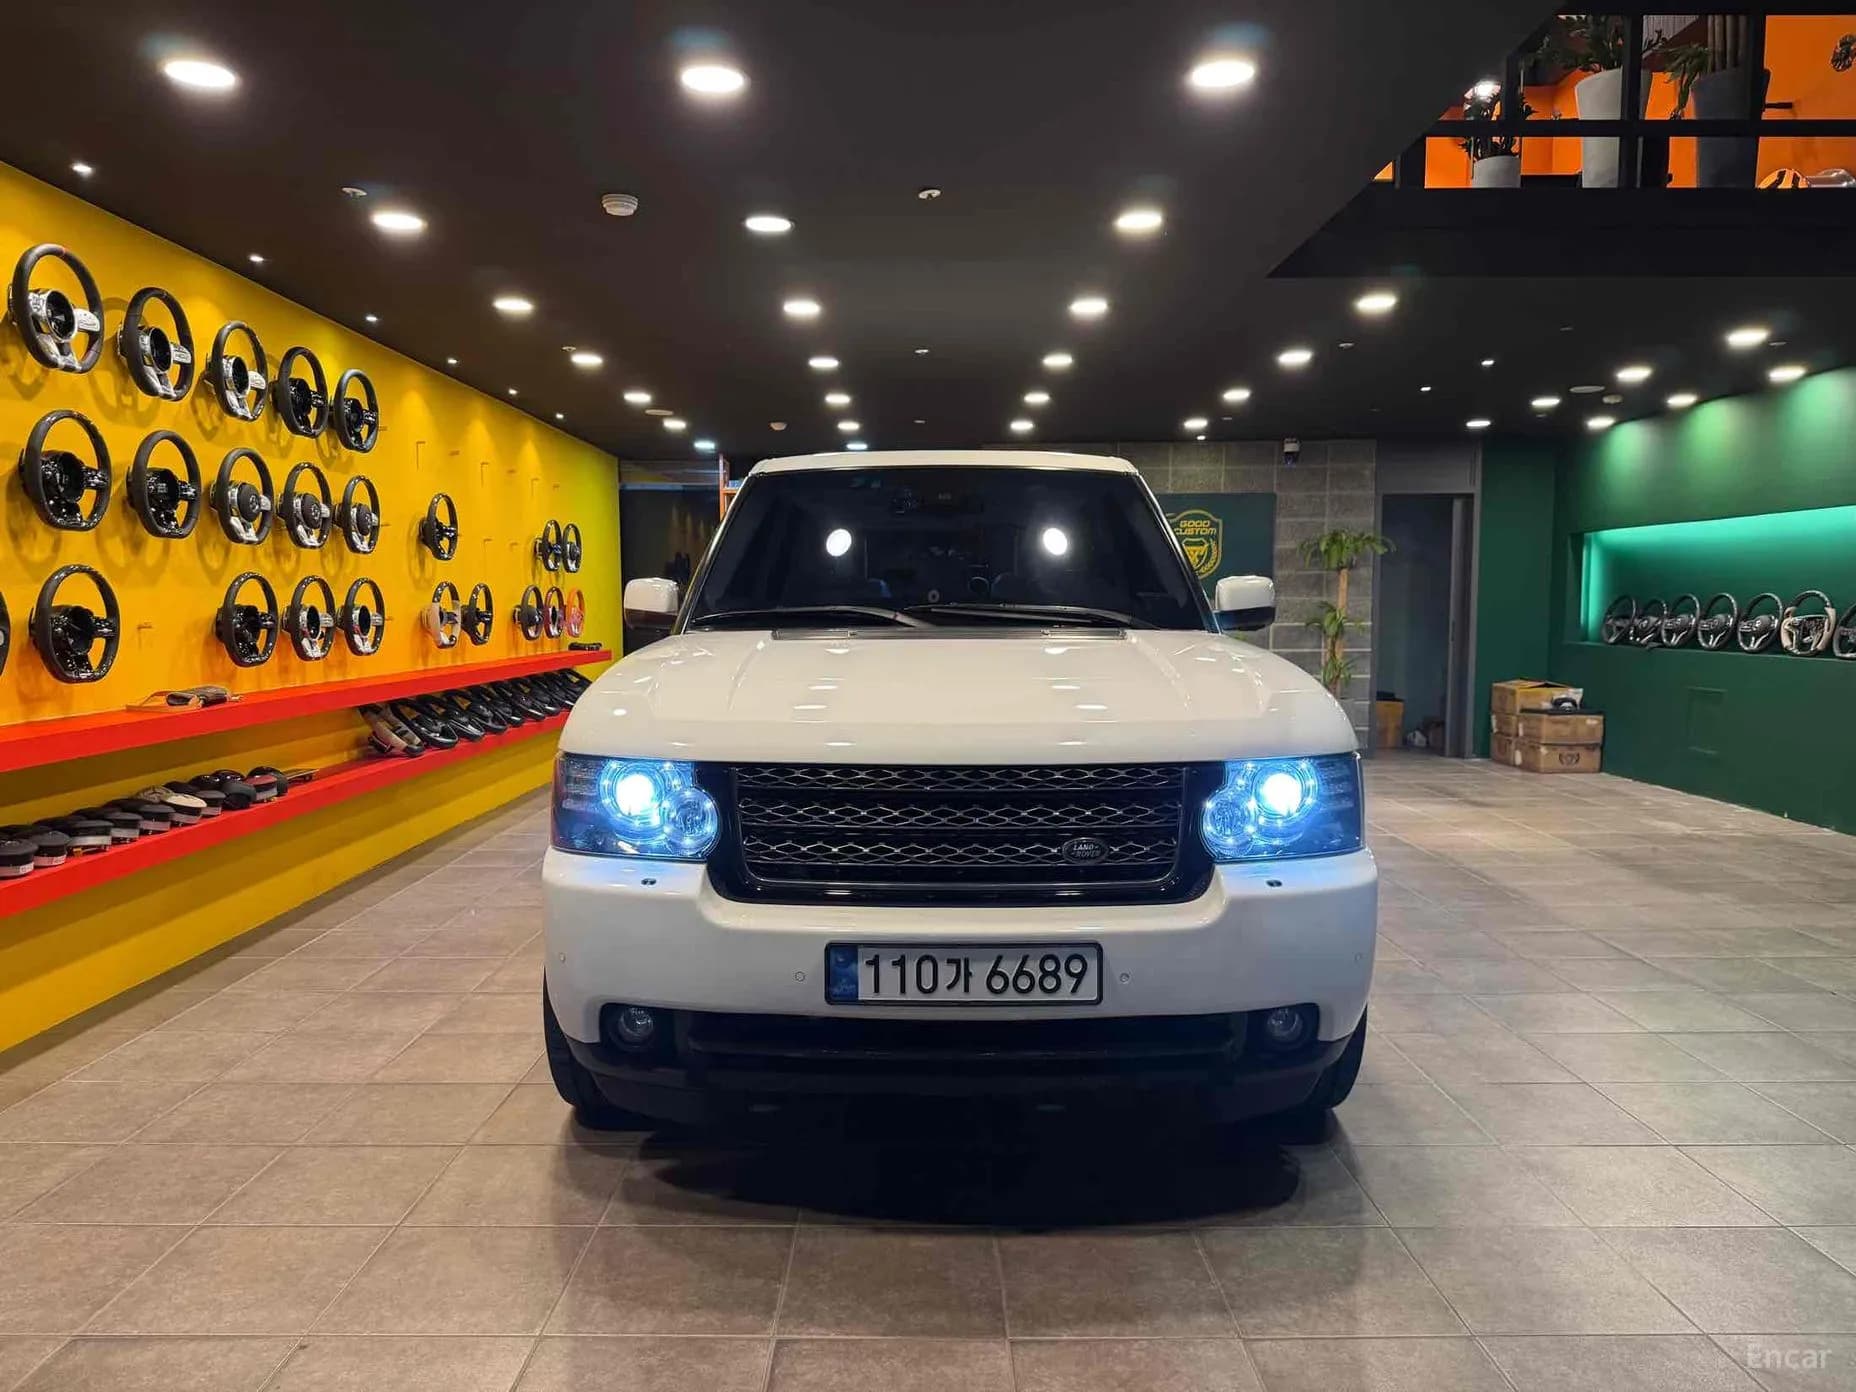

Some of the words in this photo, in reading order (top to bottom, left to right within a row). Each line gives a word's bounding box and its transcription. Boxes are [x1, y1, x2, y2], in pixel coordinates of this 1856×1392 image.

[1179, 519, 1211, 528] GOOD
[1174, 527, 1217, 536] CUSTOM
[1073, 843, 1095, 851] LAND
